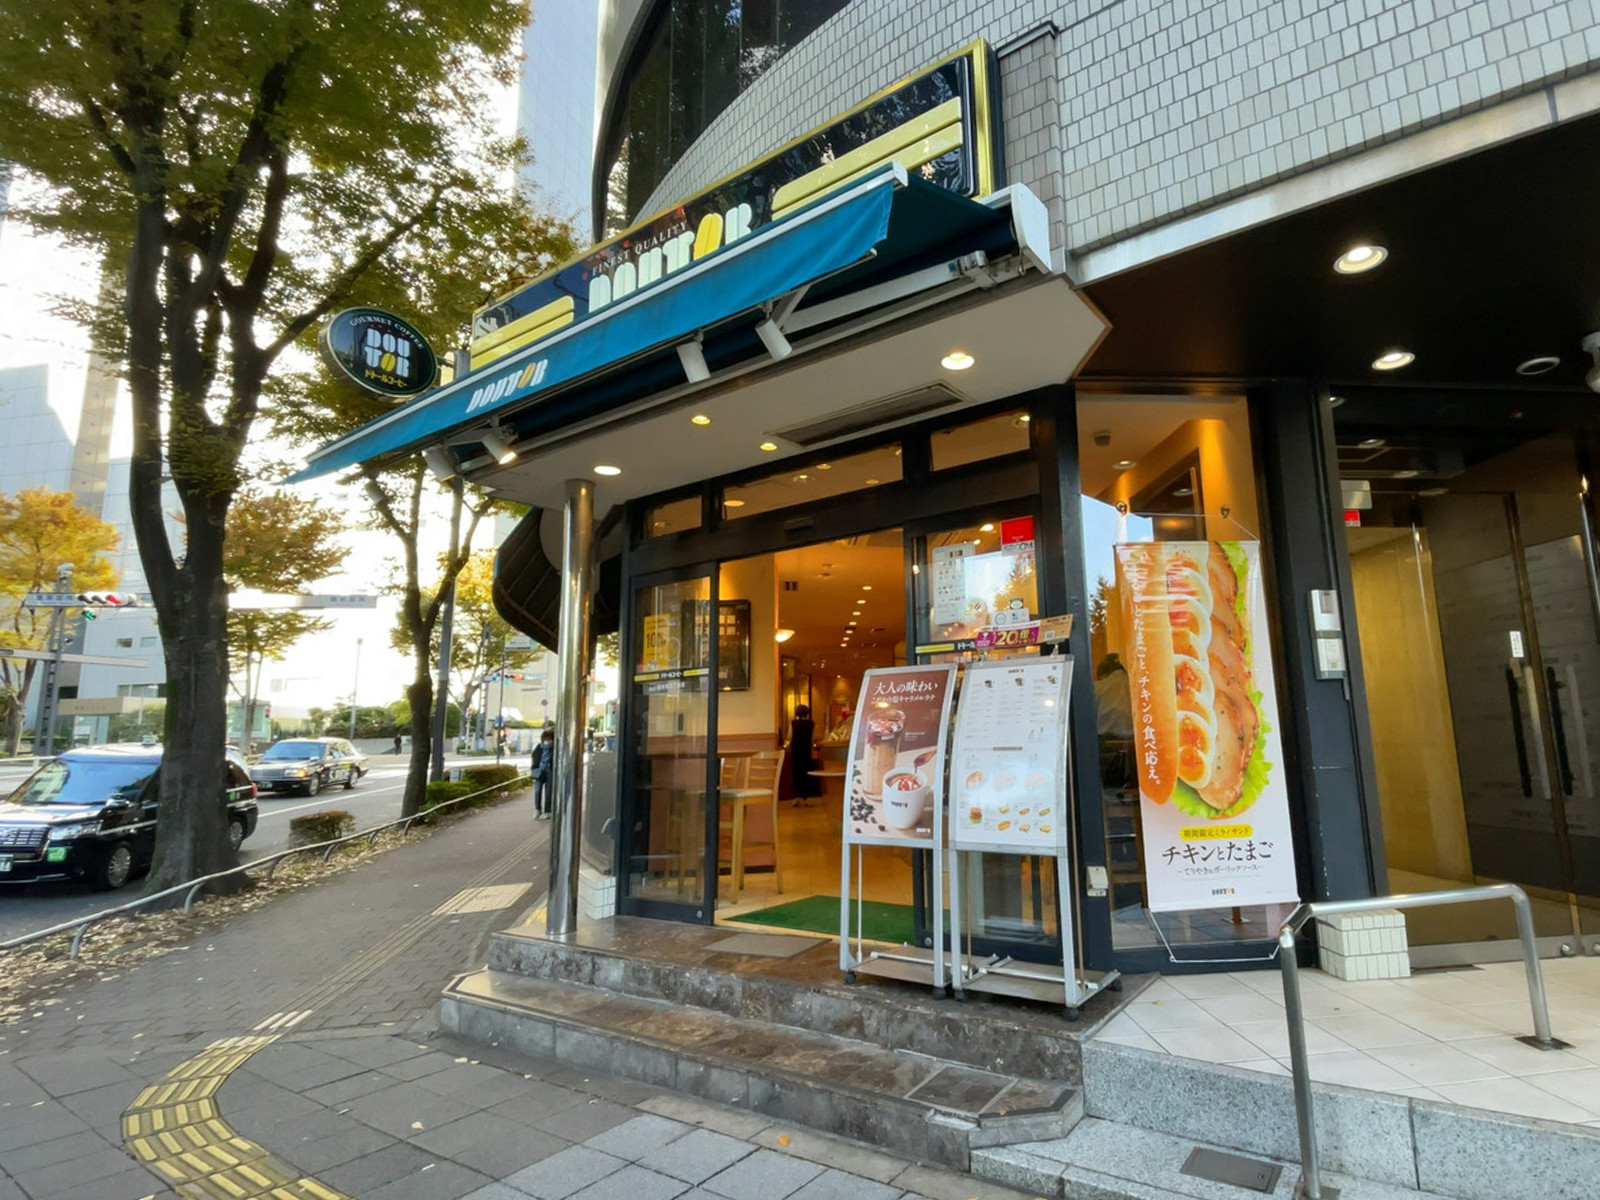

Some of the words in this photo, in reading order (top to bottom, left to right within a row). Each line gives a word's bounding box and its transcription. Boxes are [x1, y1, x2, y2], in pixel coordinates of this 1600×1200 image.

[592, 249, 631, 277] FINEST
[634, 219, 688, 256] QUALITY
[349, 315, 393, 327] GOURMET
[394, 322, 425, 350] COFFEE
[465, 358, 549, 414] DOUTOR
[873, 680, 938, 696] 大人の味わい
[1183, 825, 1250, 838] 期間限定ミラノサンド
[1162, 839, 1274, 866] チキンとたまご
